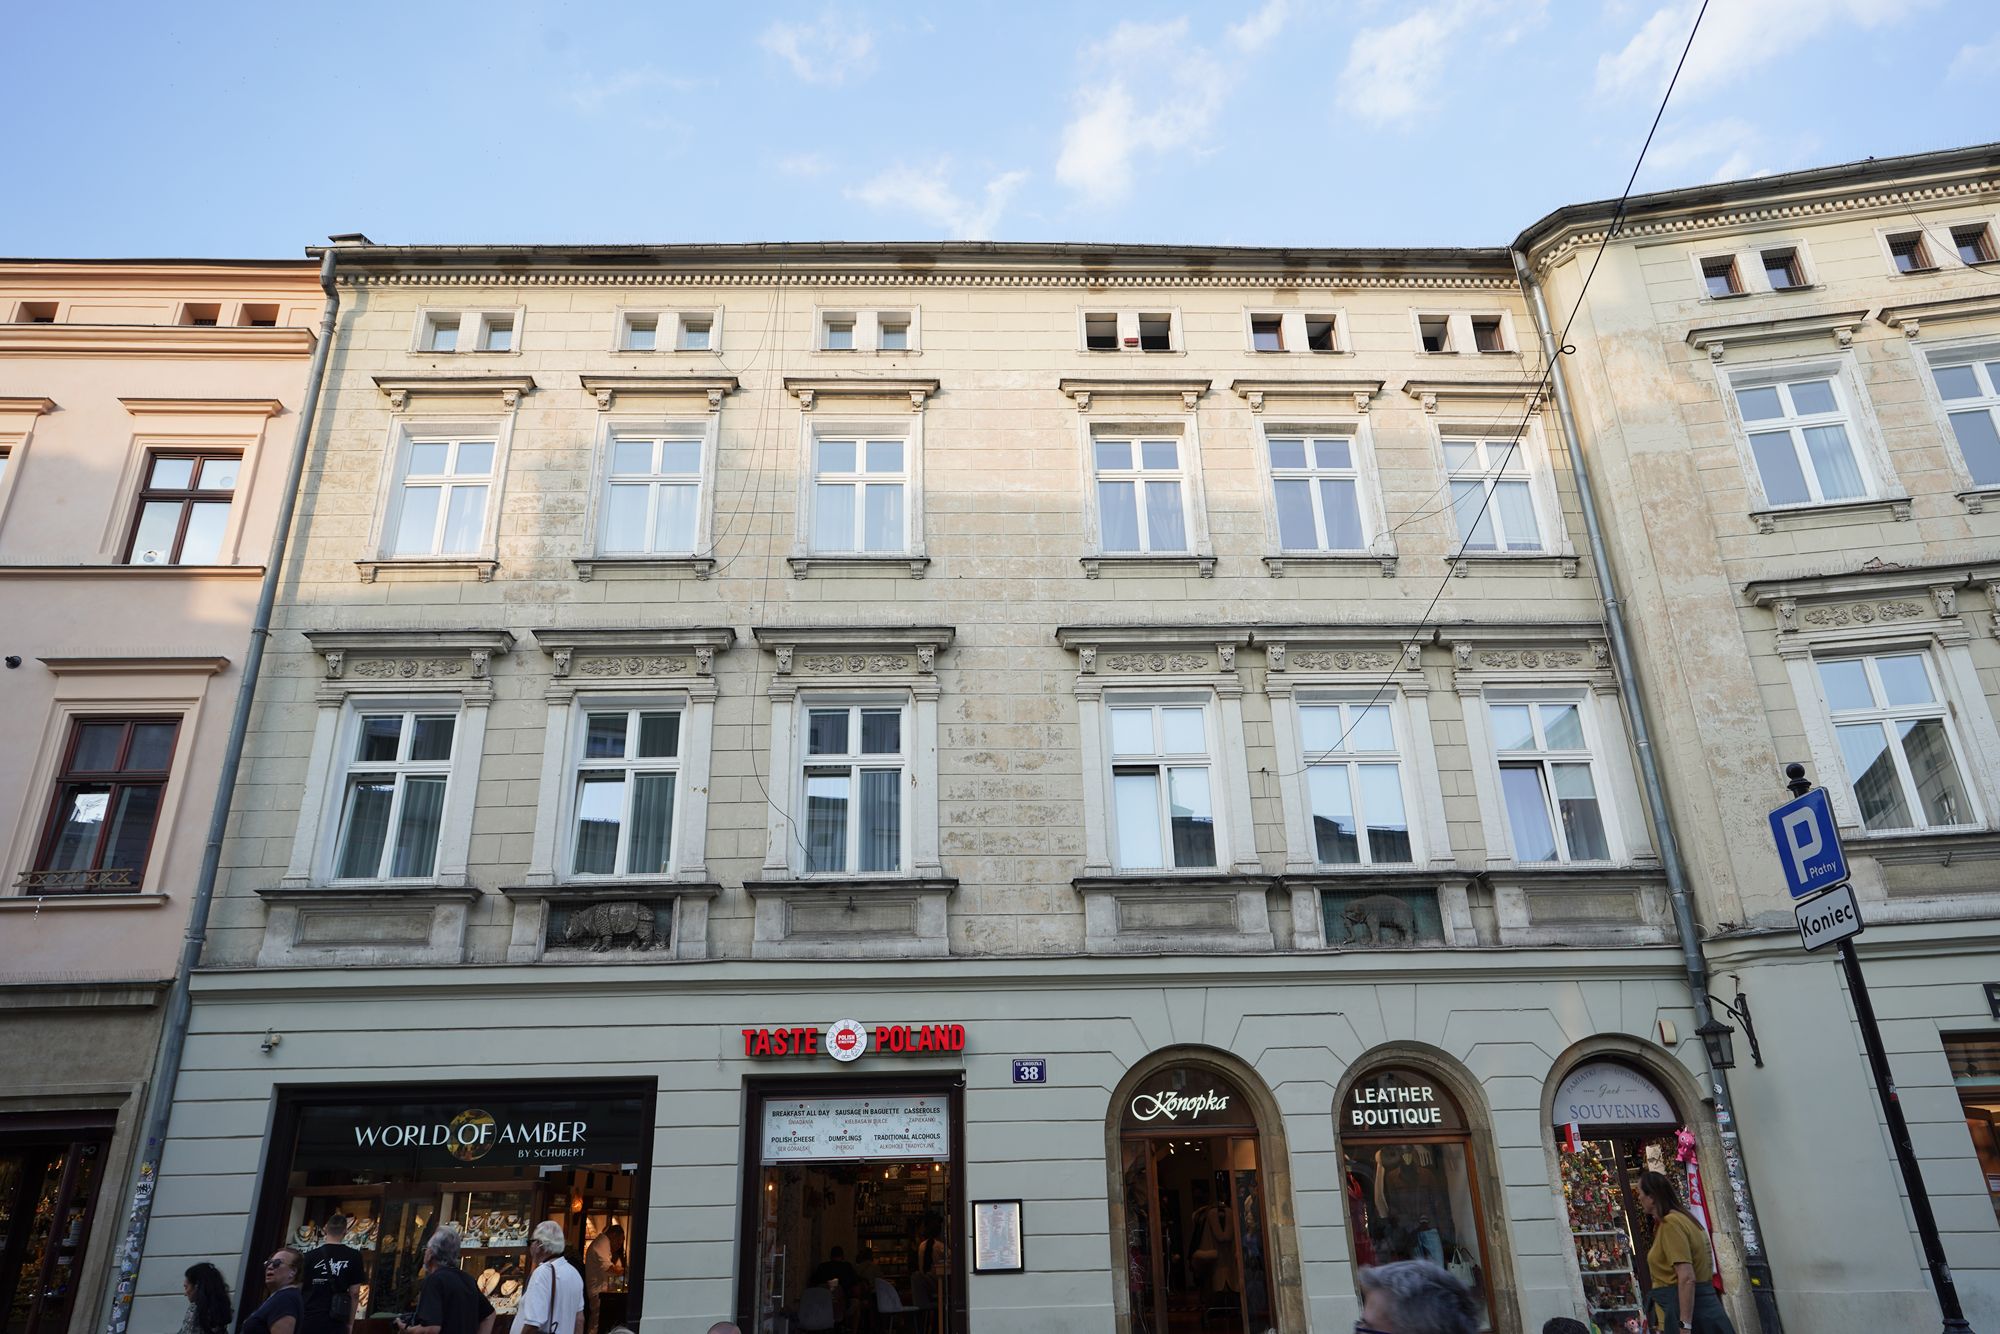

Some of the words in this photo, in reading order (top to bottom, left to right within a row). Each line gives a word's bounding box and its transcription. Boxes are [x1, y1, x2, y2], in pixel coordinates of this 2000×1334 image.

[1781, 806, 1823, 884] P
[1809, 861, 1838, 879] Płatny
[1800, 904, 1854, 938] Koniec
[742, 1027, 818, 1057] TASTE
[875, 1024, 966, 1054] POLAND
[1020, 1066, 1039, 1080] 38
[1354, 1086, 1434, 1104] LEATHER
[806, 1109, 816, 1117] ALL
[1131, 1088, 1230, 1121] Konopka
[1569, 1103, 1661, 1120] SOUVENIRS
[1352, 1107, 1442, 1126] BOUTIQUE
[355, 1124, 450, 1147] WORLD
[458, 1123, 494, 1145] OF
[499, 1121, 587, 1144] AMBER
[518, 1149, 530, 1158] BY
[534, 1148, 586, 1158] SCHUBERT
